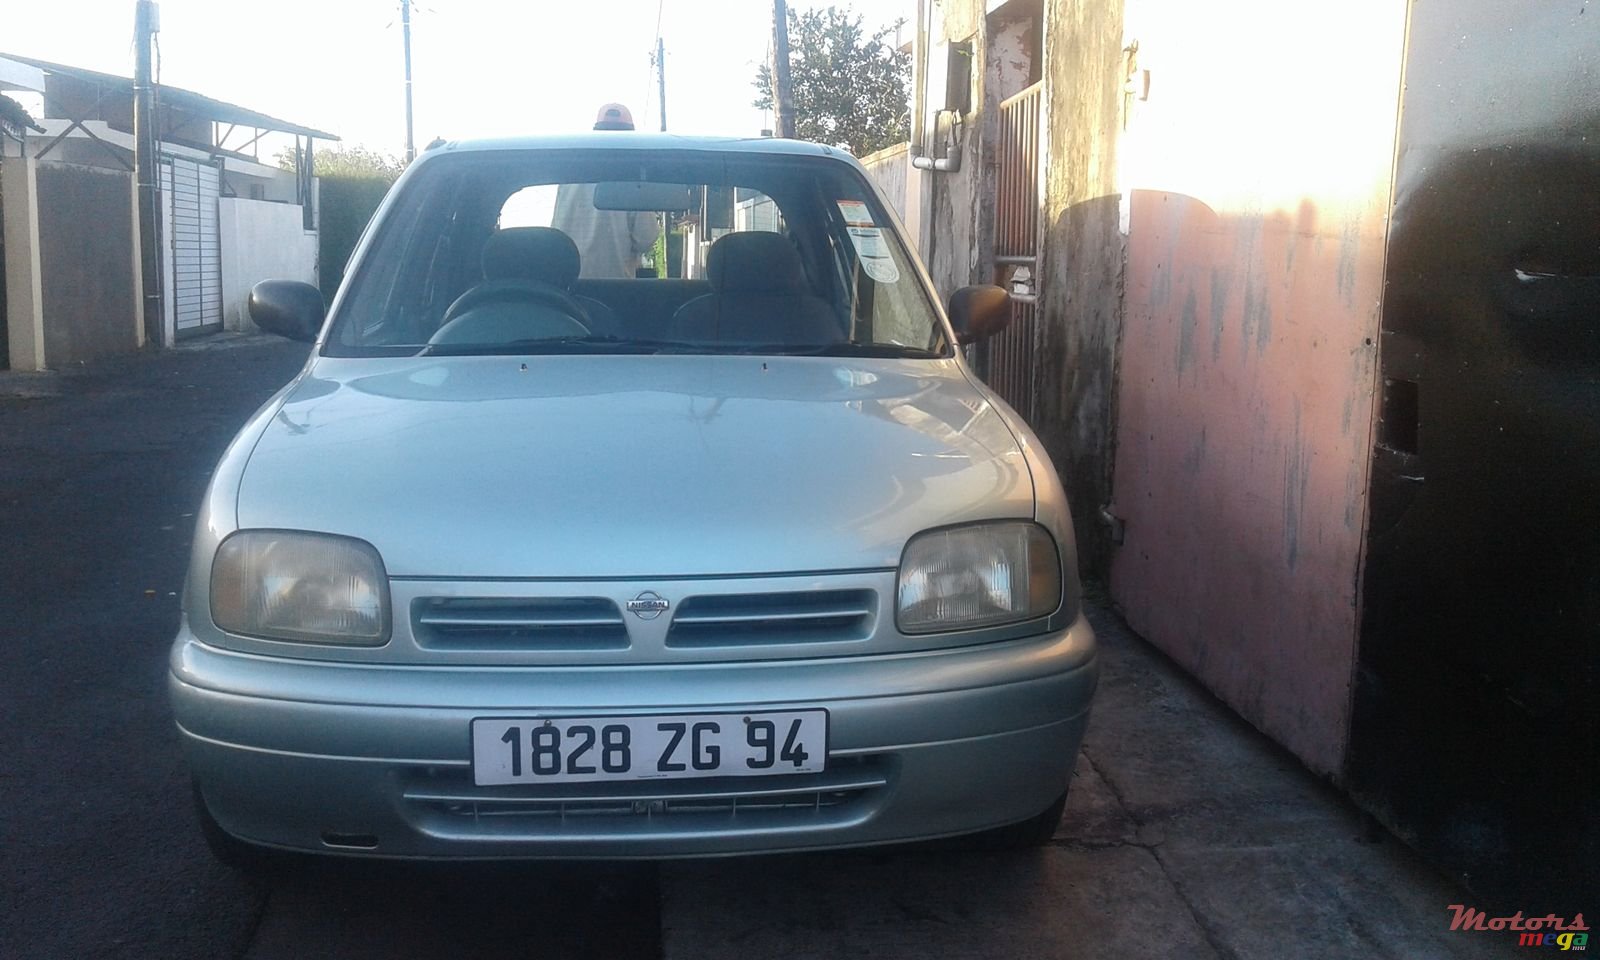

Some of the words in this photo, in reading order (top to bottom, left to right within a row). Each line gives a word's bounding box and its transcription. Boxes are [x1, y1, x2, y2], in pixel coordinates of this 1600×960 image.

[631, 601, 665, 609] NISSAN
[500, 725, 632, 777] 1828
[656, 722, 721, 772] ZG
[746, 719, 808, 768] 94
